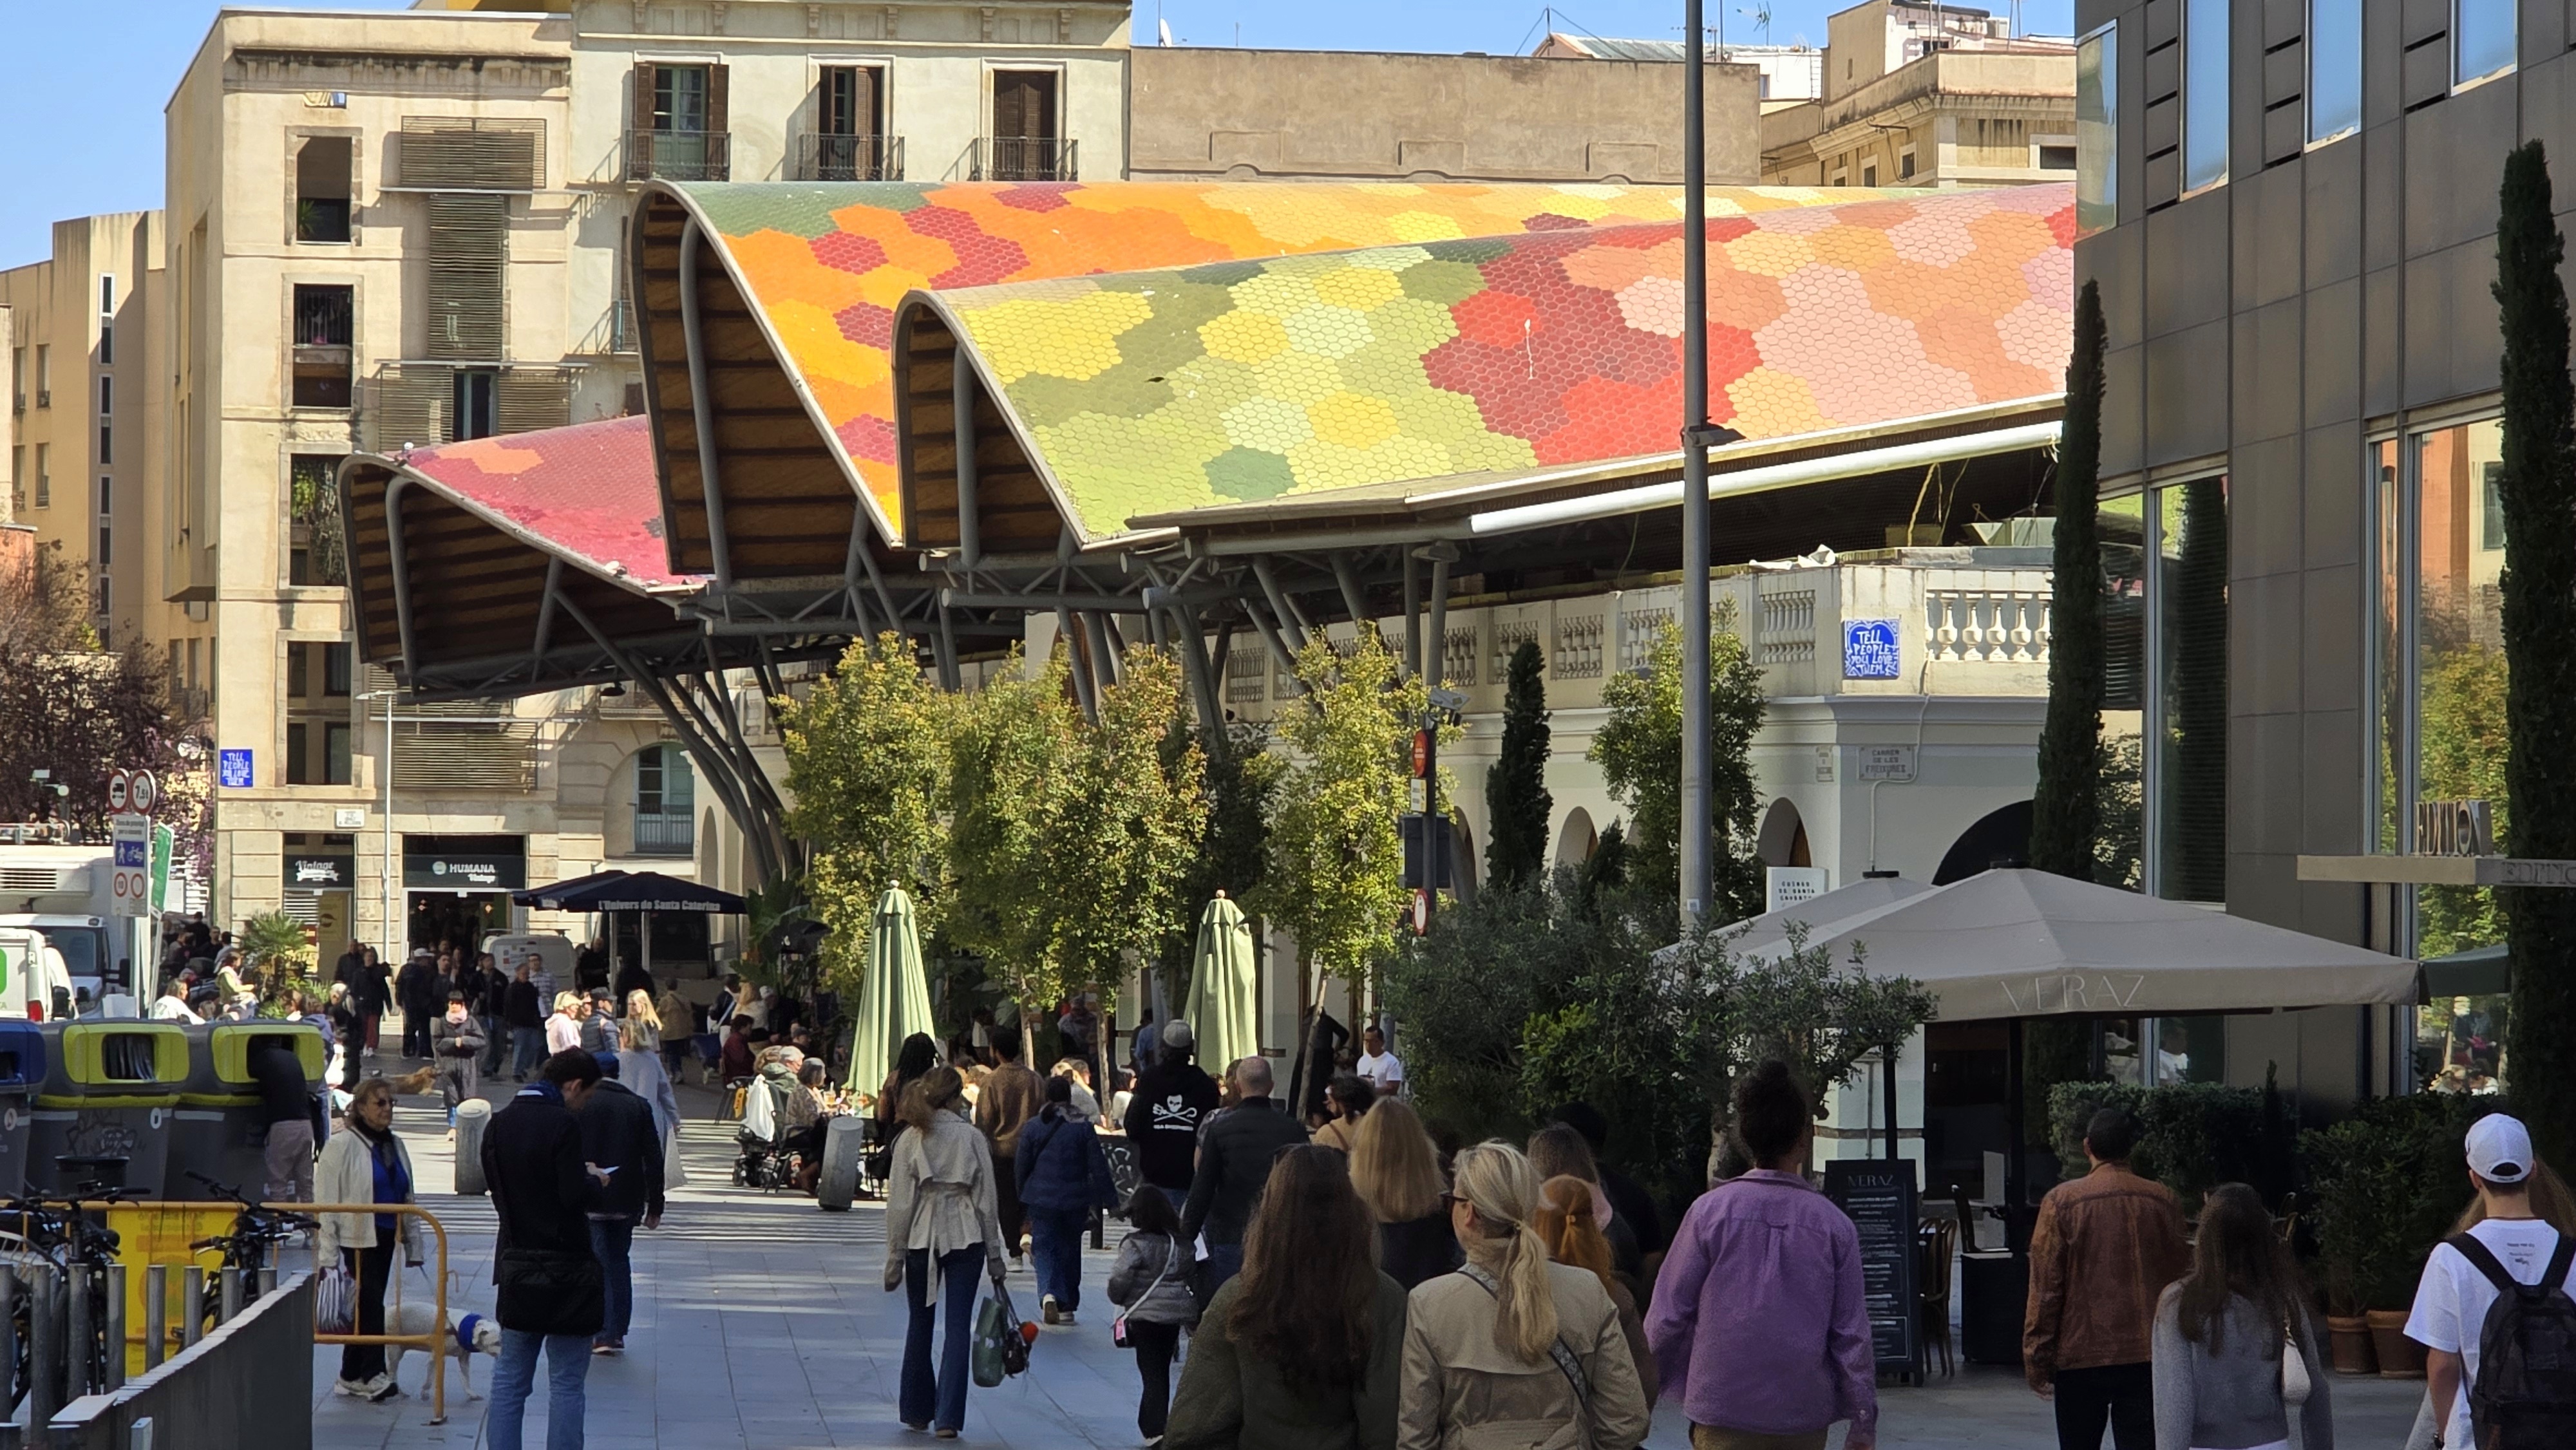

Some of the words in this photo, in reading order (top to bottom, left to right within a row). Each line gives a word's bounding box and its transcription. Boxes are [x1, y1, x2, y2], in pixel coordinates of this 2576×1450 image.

[1856, 630, 1883, 644] TELL
[1853, 643, 1891, 655] PEOPLE
[1851, 655, 1868, 664] YOU
[1872, 655, 1893, 664] LOVE
[225, 752, 243, 760] TELL
[2410, 799, 2492, 856] EDITION
[295, 860, 334, 871] Vintage
[449, 863, 496, 873] HUMANA
[2501, 862, 2576, 885] EDITIO
[641, 899, 652, 910] de
[654, 899, 680, 910] Santa
[682, 900, 721, 911] Caterina
[2000, 974, 2146, 1012] VERAZ
[1846, 1174, 1894, 1187] VERAZ
